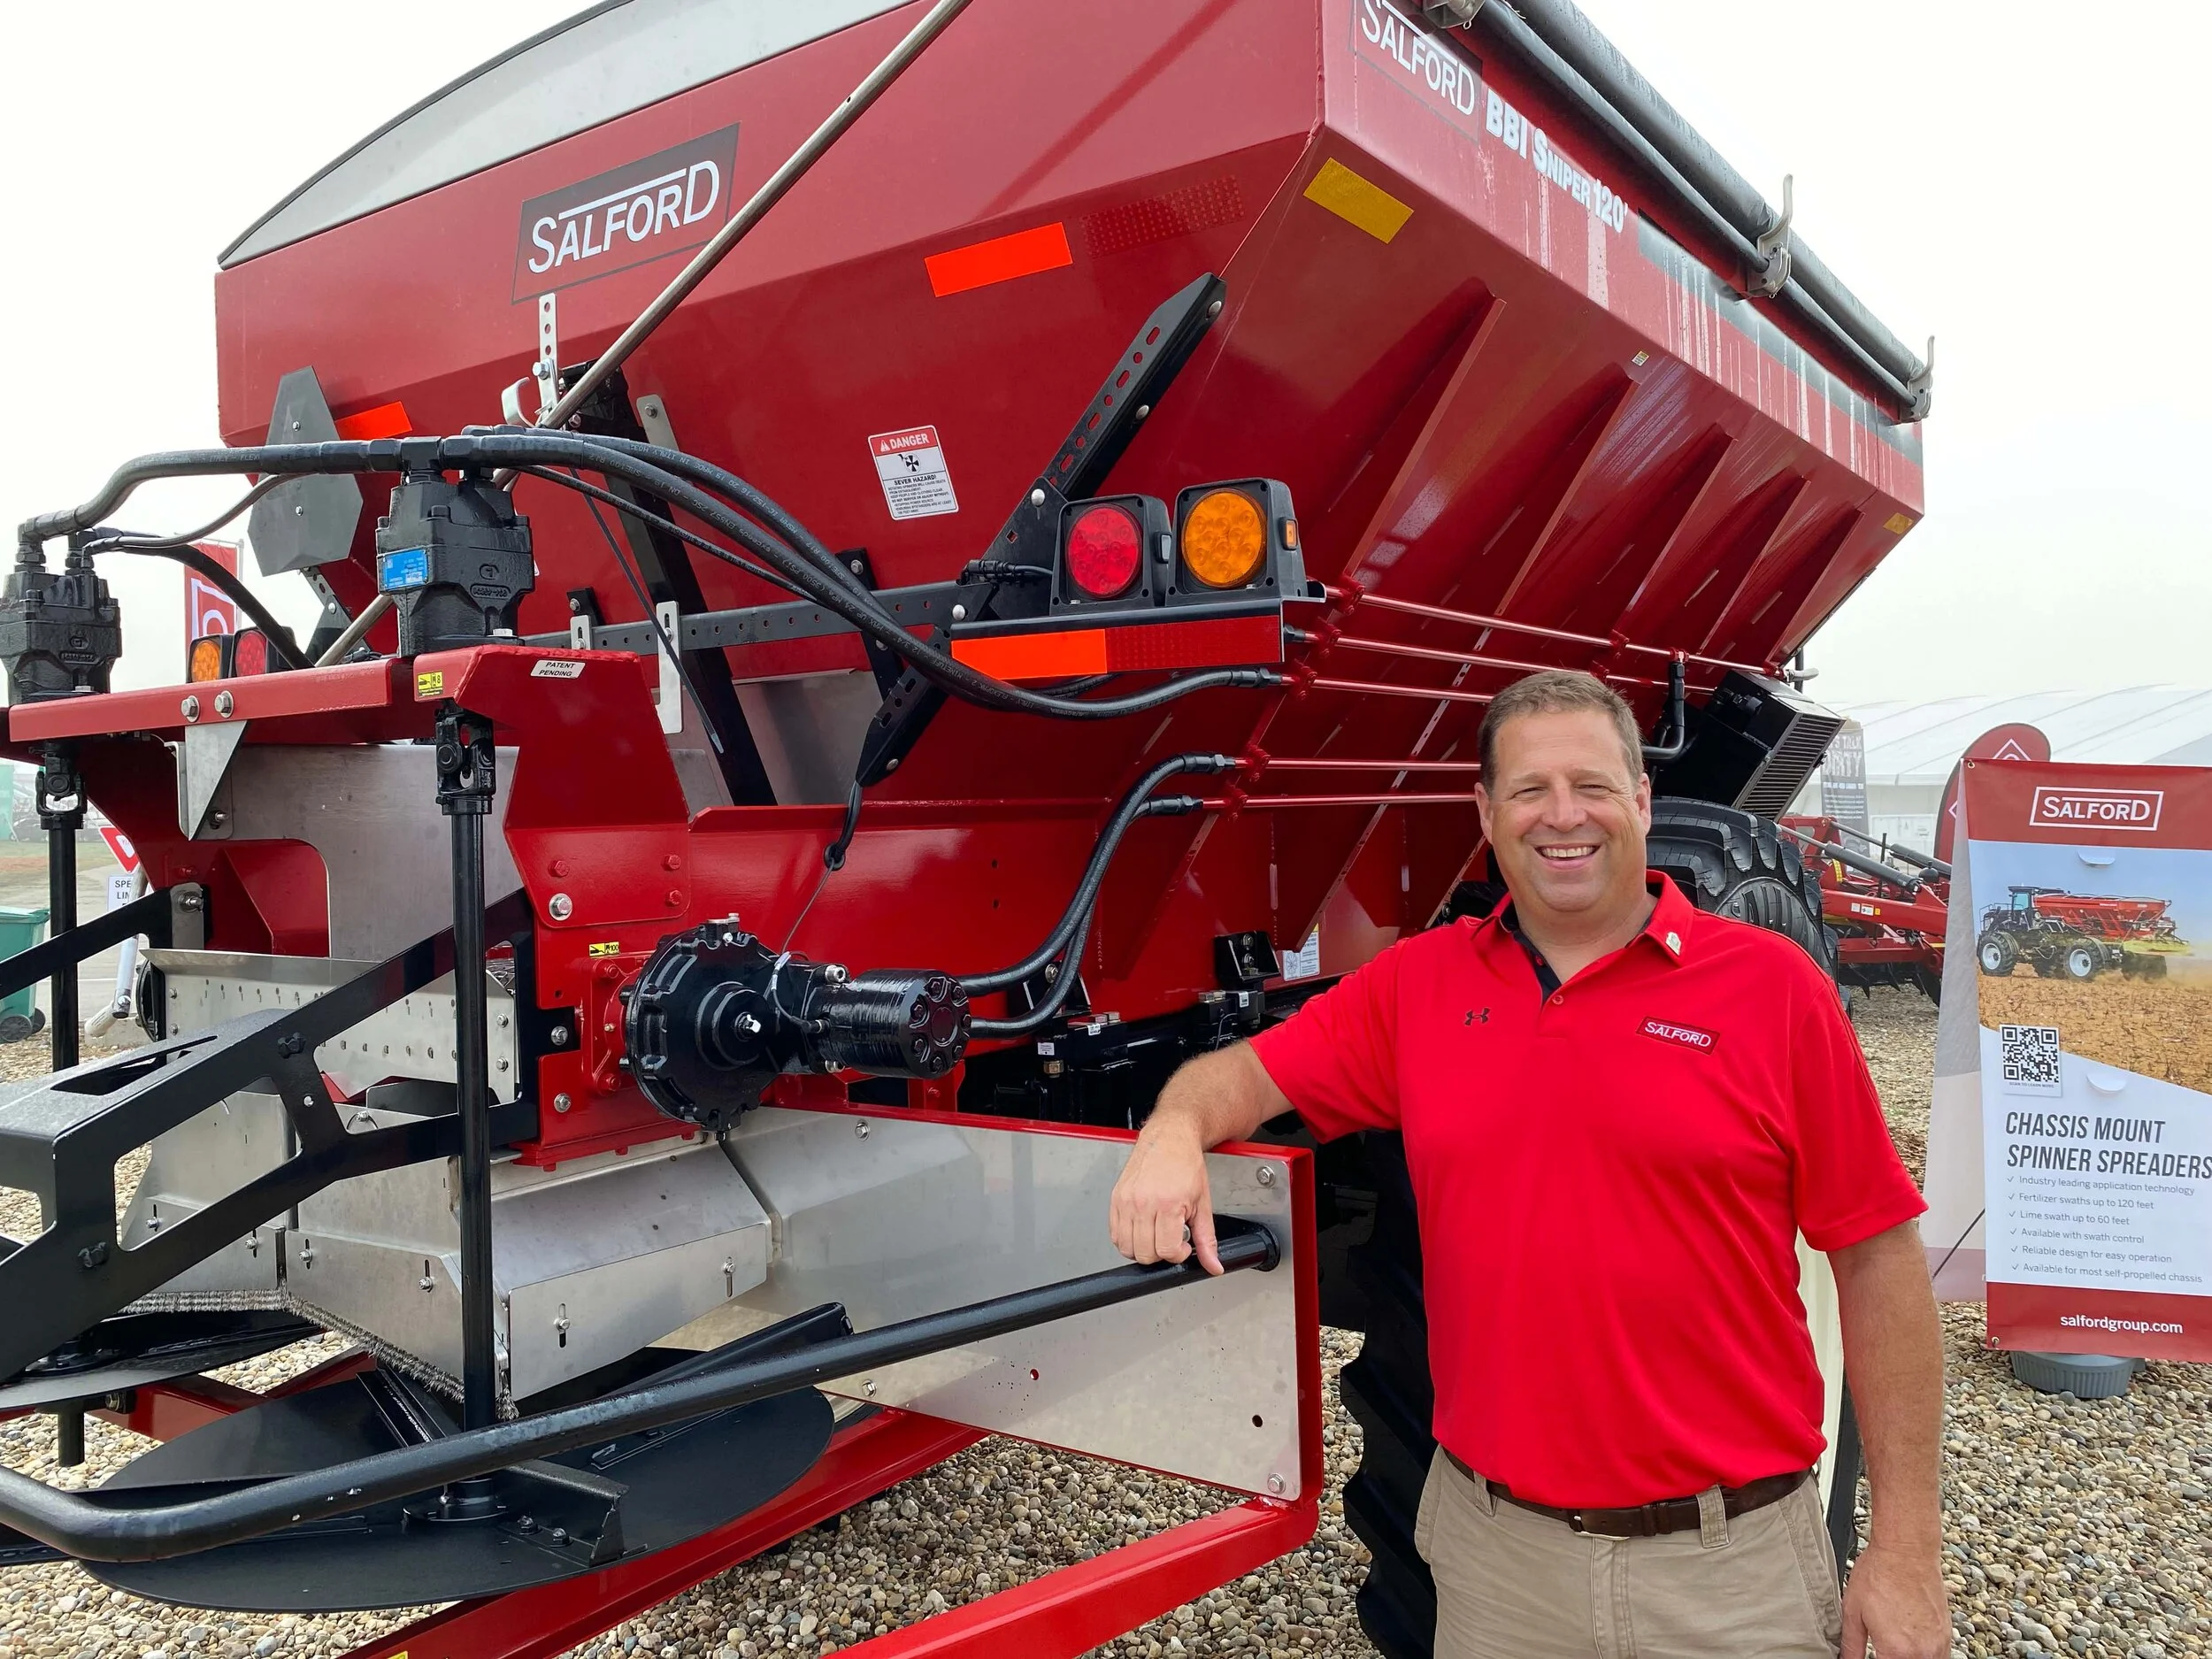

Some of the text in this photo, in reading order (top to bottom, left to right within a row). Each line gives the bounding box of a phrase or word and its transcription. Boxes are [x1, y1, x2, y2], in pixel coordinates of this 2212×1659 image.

[1361, 0, 1476, 116] SALFORD
[1486, 88, 1528, 160] BBI
[528, 160, 720, 273] SALFORD
[889, 433, 930, 449] DANGER
[2042, 795, 2151, 822] SALFORD
[1645, 1022, 1712, 1048] SALFORD
[2005, 1112, 2165, 1143] CHASSIS MOUNT
[2007, 1144, 2212, 1179] SPINNER SPREADERS
[2020, 1176, 2194, 1196] Industry leading application technology
[2020, 1194, 2154, 1210] Fertilizer swaths up to 120 feet
[2020, 1210, 2042, 1220] Lime
[2044, 1212, 2070, 1222] swath
[2072, 1215, 2084, 1224] up
[2112, 1216, 2130, 1225] feet
[2022, 1228, 2061, 1239] Available
[2062, 1231, 2081, 1240] with
[2084, 1233, 2110, 1241] swath
[2022, 1246, 2172, 1263] Reliable design for easy operation
[2023, 1263, 2202, 1283] Available for most self-propelled chassis
[2060, 1314, 2184, 1334] salfordgroup.com
